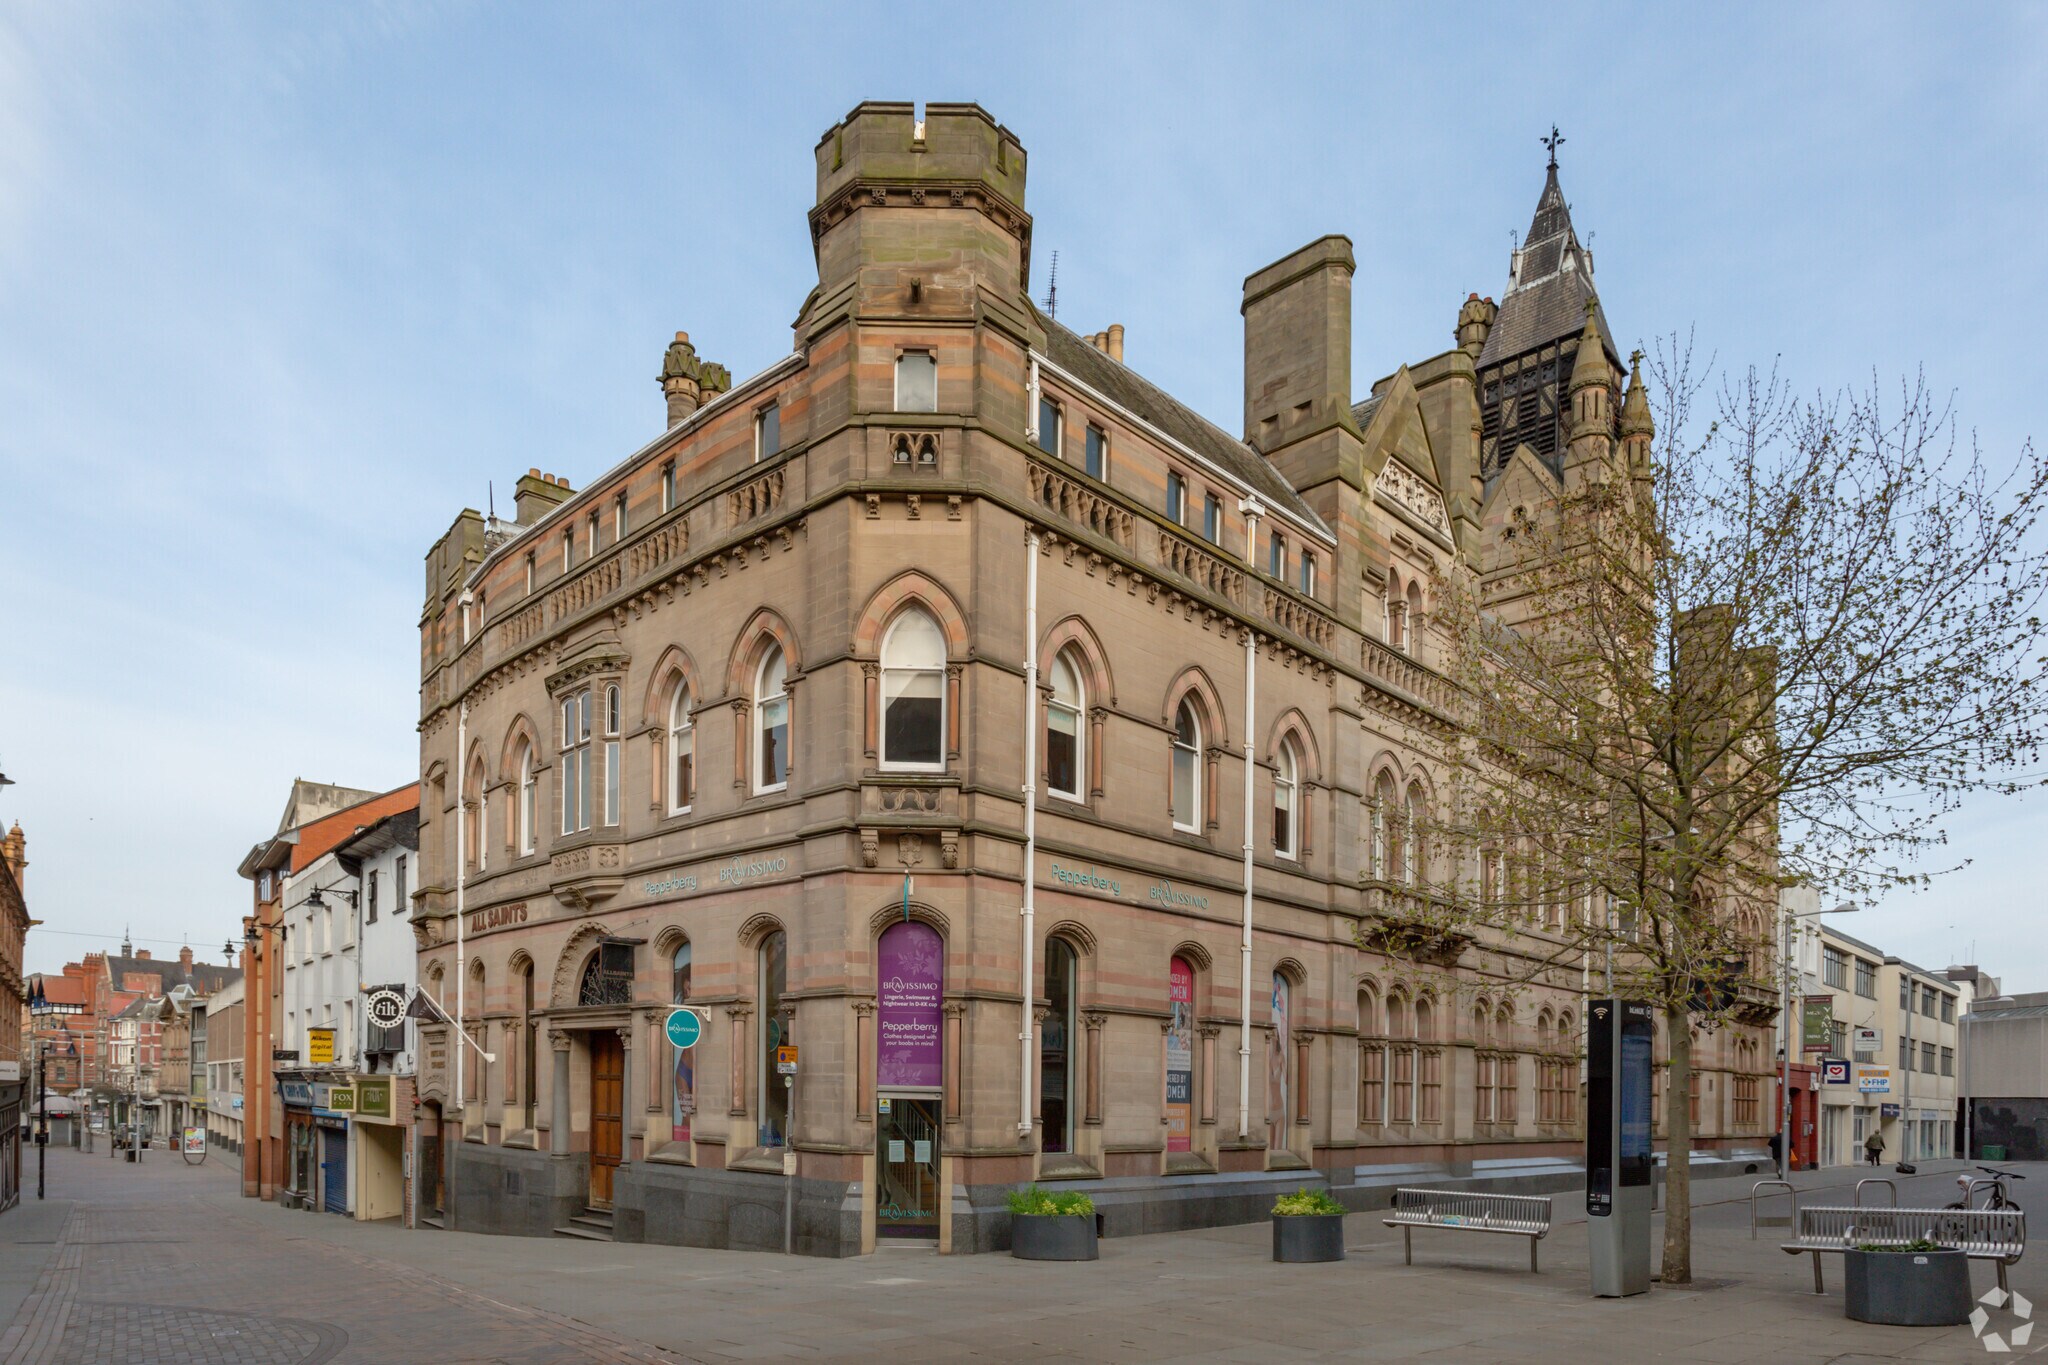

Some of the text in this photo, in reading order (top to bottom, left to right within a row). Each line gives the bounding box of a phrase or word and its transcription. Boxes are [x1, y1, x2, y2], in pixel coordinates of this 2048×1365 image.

[644, 856, 786, 895] Pepperberry BRAVISSIMO
[1151, 879, 1208, 909] BRAVISSIMO
[883, 976, 938, 993] BRAVISSIMO
[375, 1001, 397, 1017] tilt
[883, 1018, 938, 1033] Pepperberry
[902, 1033, 926, 1041] designed
[311, 1043, 332, 1051] digital
[1180, 1074, 1187, 1084] BY
[1871, 1078, 1888, 1086] FHP
[333, 1093, 352, 1102] FOX
